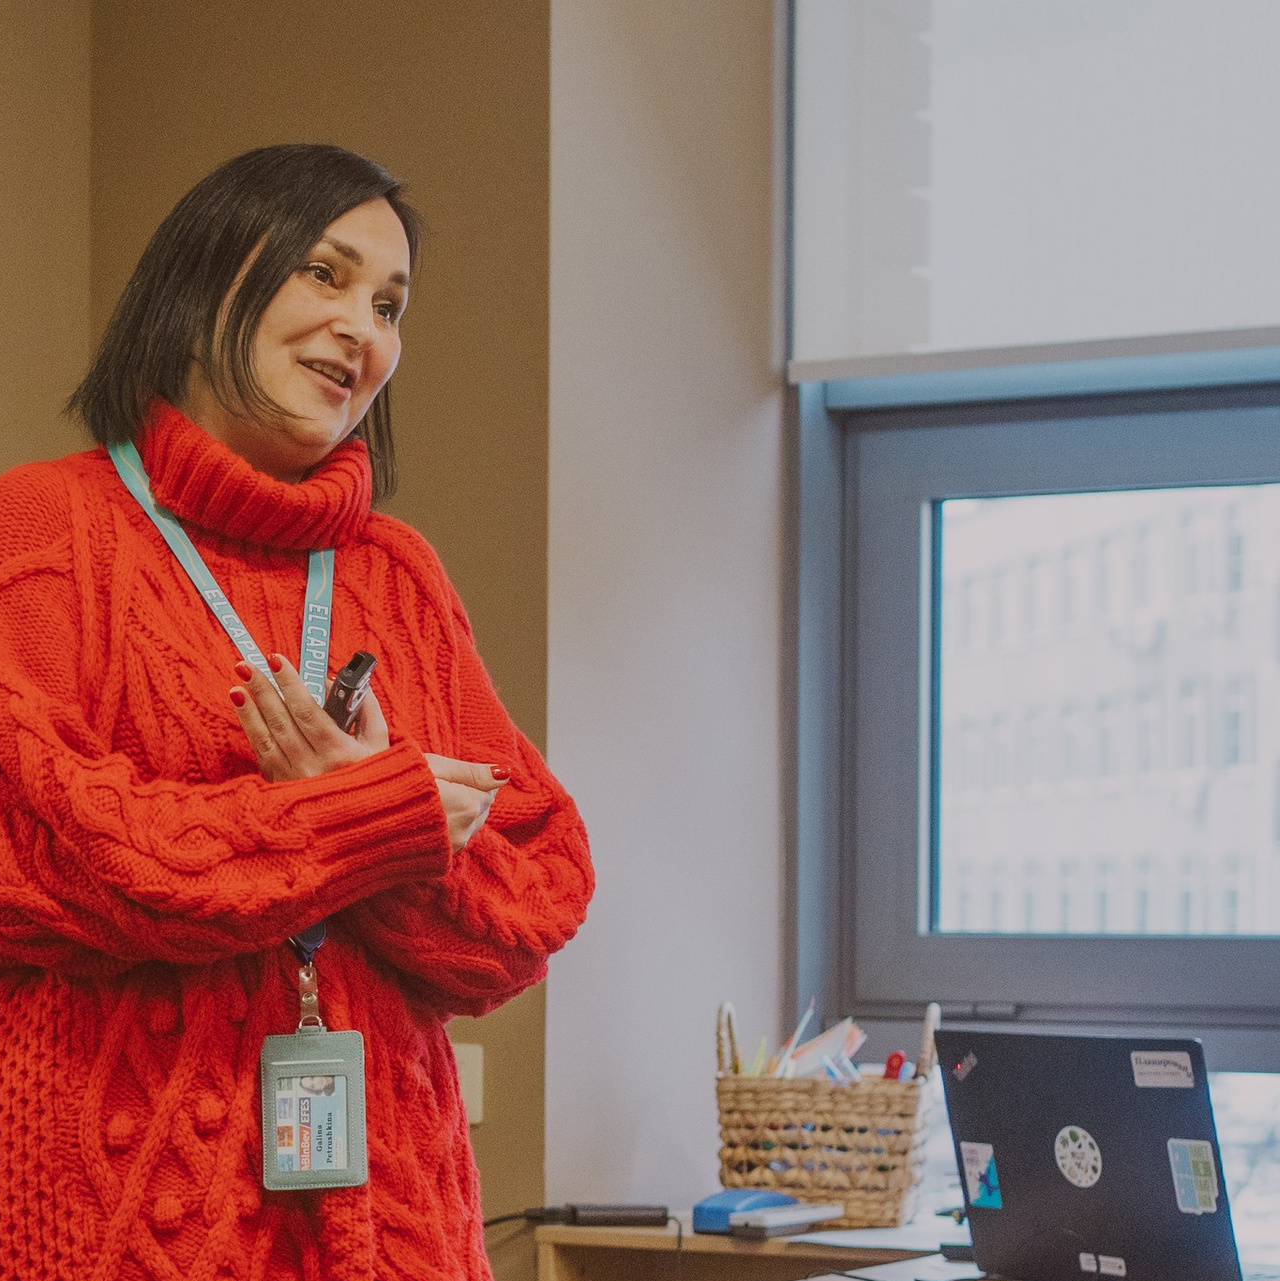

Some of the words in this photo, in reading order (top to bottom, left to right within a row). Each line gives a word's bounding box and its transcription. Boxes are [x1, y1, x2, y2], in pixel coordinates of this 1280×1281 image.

[308, 603, 329, 622] EL
[204, 588, 228, 611] EL
[221, 614, 276, 680] CAPU
[300, 1099, 310, 1124] EFES
[325, 1112, 333, 1164] Petrushkina
